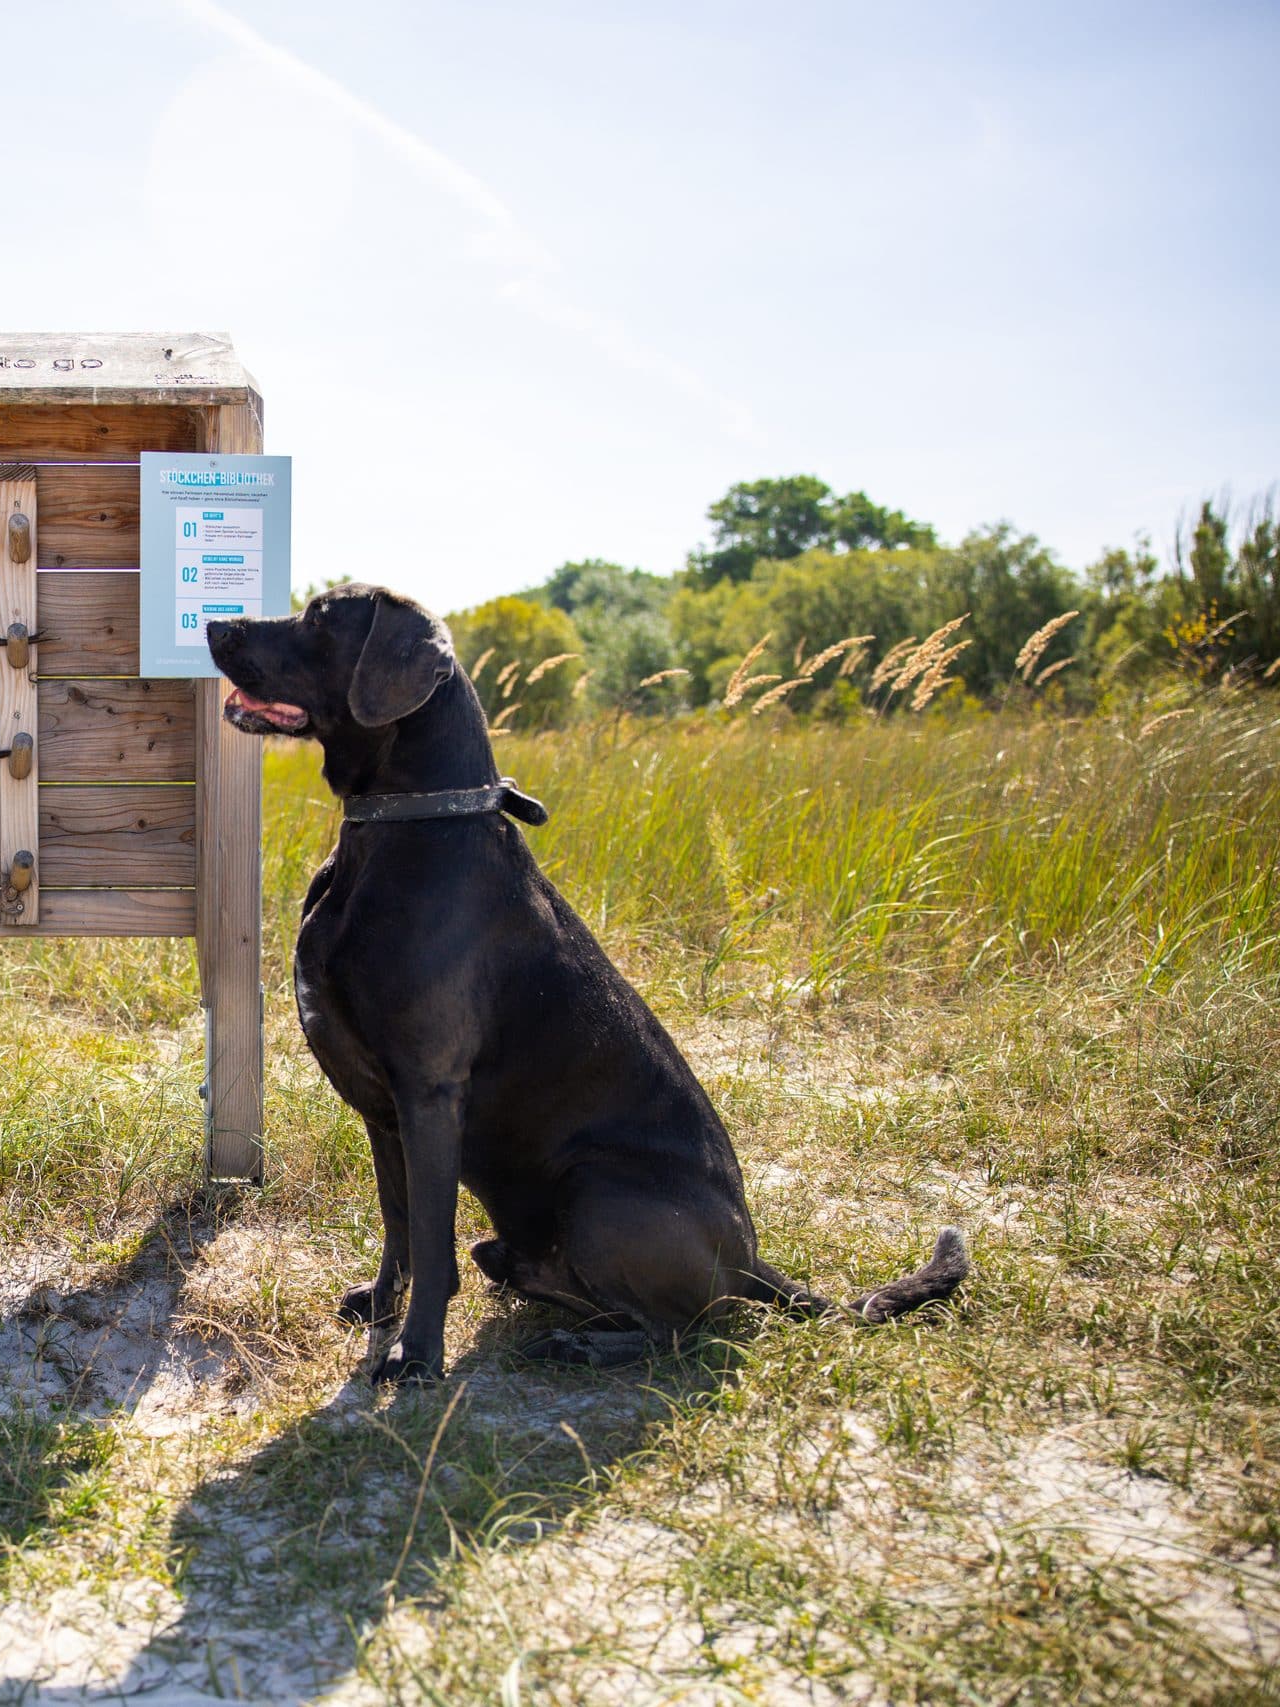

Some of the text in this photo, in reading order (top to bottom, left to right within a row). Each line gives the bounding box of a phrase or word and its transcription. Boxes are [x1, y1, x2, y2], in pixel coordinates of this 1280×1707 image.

[52, 358, 104, 372] go
[160, 469, 275, 486] STÖCKCHEN-BIBLIOTHEK
[183, 522, 197, 538] 01
[182, 567, 198, 583] 02
[182, 613, 198, 629] 03
